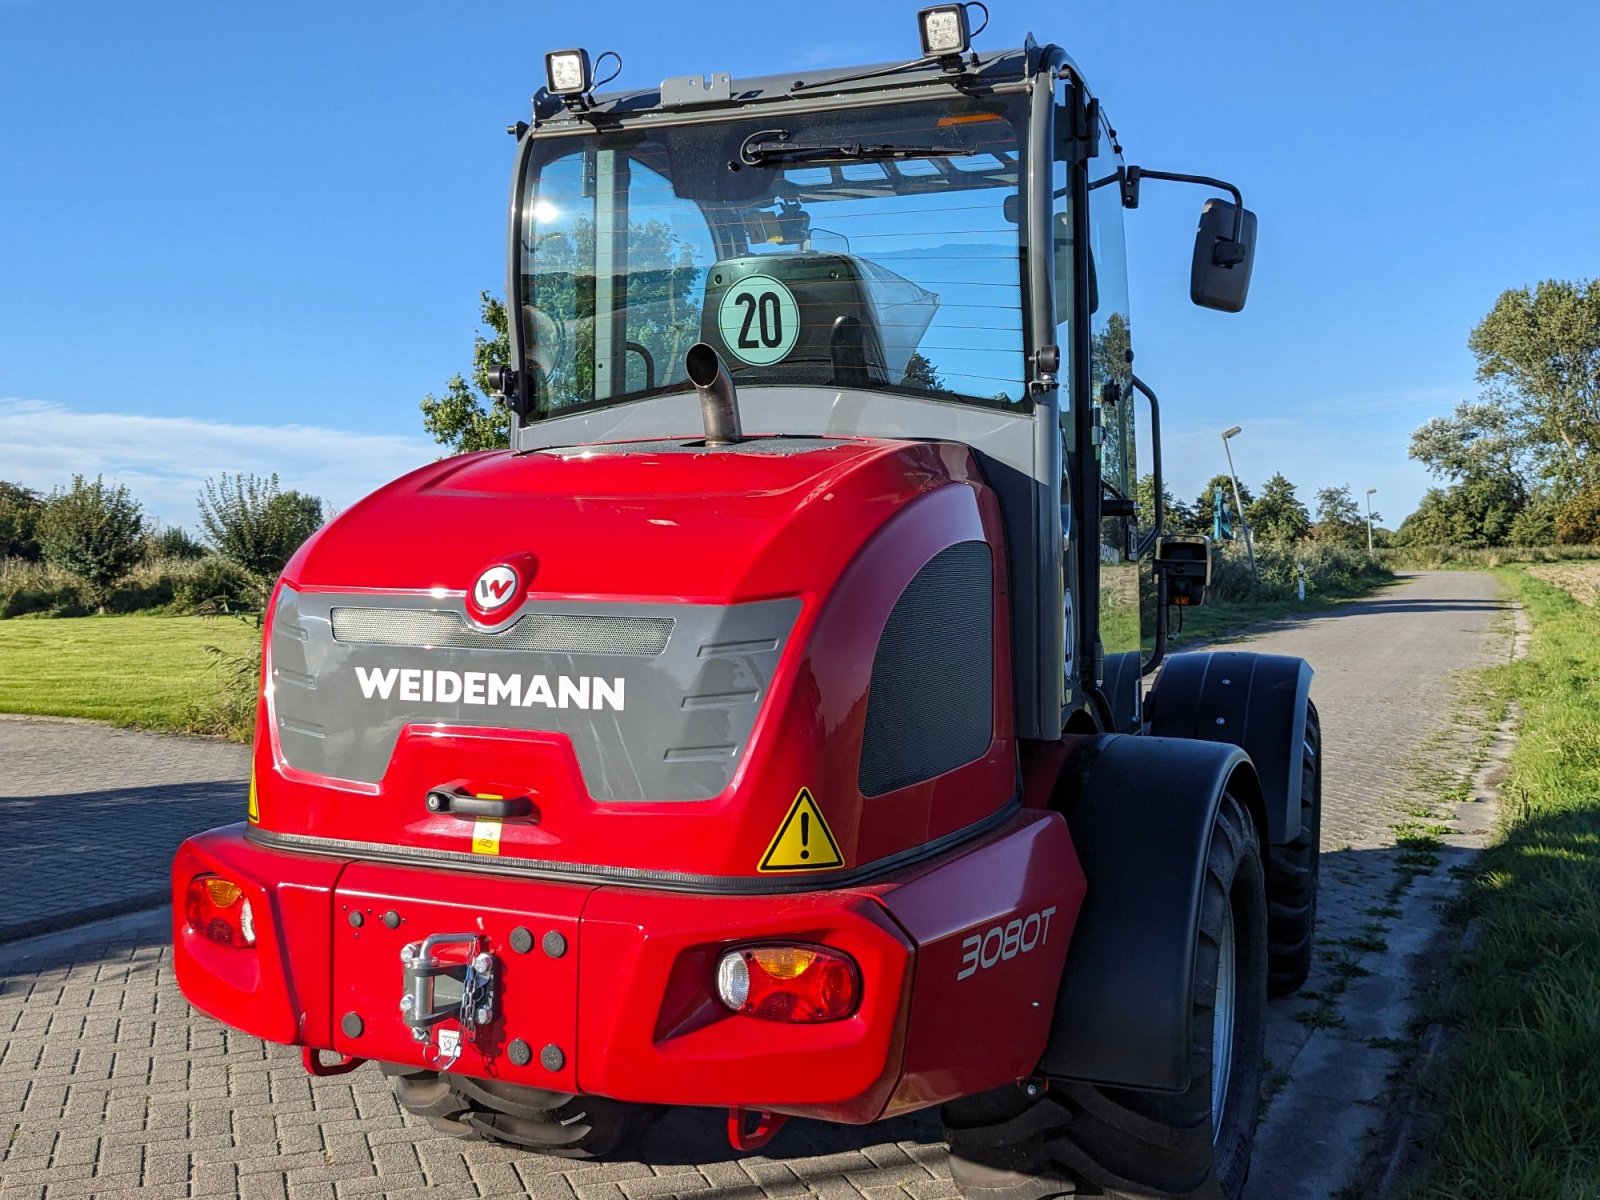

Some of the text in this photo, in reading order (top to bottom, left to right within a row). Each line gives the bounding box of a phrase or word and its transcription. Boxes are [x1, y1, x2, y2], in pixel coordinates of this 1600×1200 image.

[735, 291, 783, 349] 20
[354, 666, 626, 711] WEIDEMANN
[957, 905, 1057, 981] 3080T
